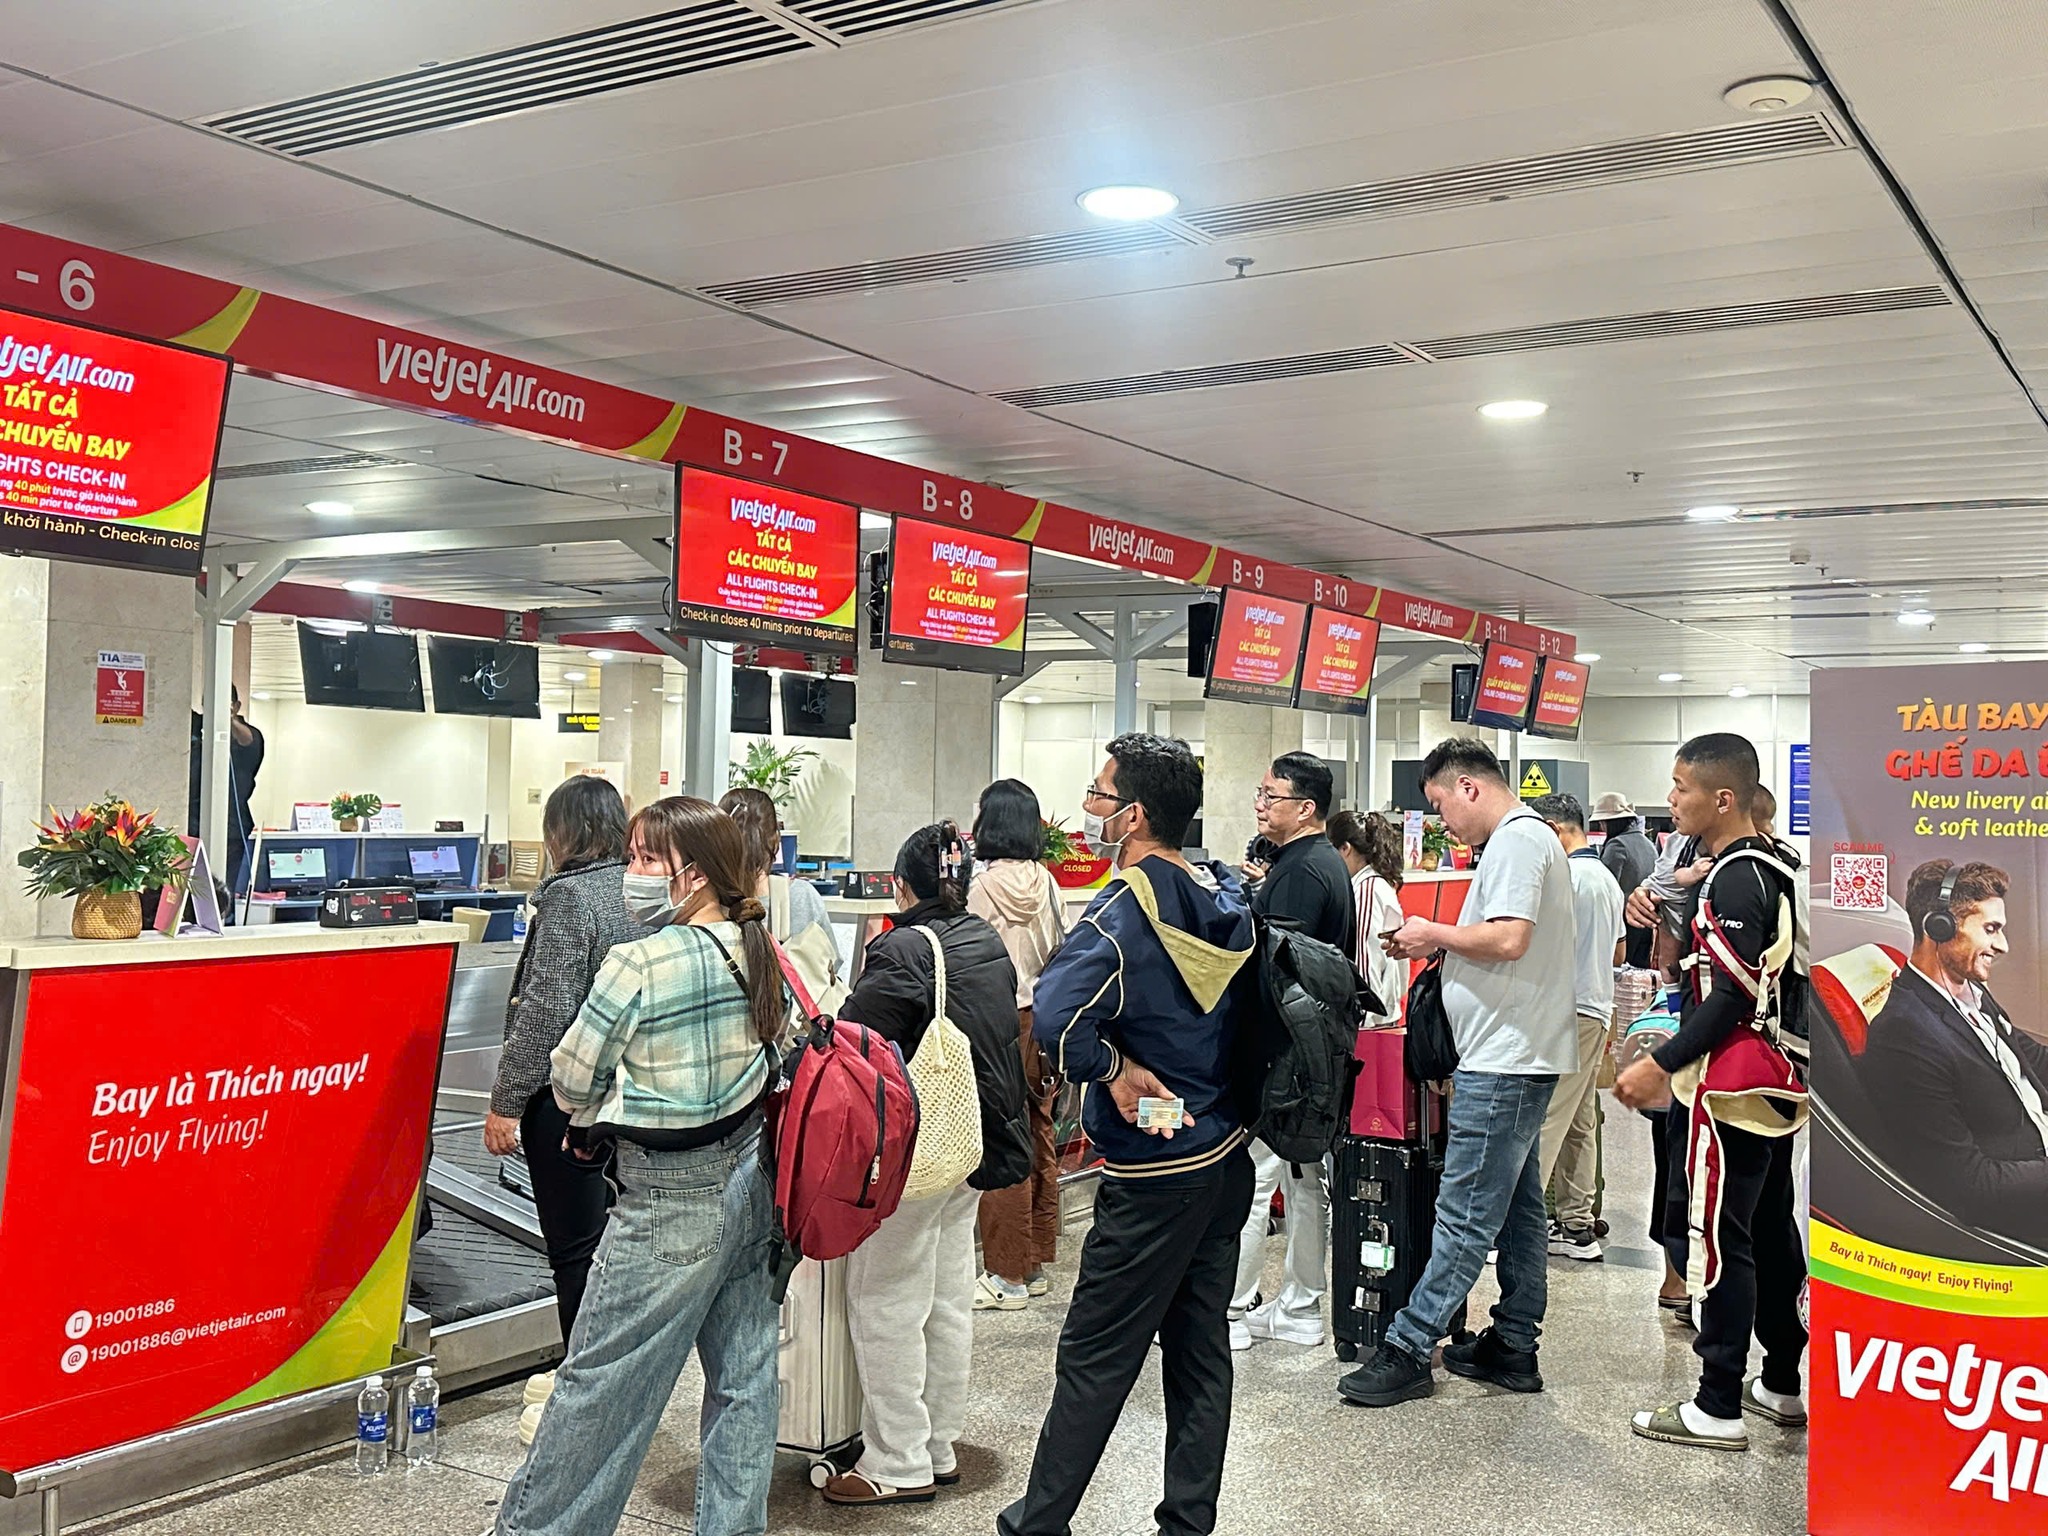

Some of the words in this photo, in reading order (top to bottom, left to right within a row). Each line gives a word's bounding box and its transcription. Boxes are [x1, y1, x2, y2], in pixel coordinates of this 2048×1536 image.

[60, 260, 95, 311] 6
[4, 380, 46, 411] TẤT
[49, 388, 78, 418] CẢ
[85, 435, 131, 461] BAY
[723, 428, 743, 466] B
[772, 441, 789, 476] 7
[15, 480, 28, 490] 40
[29, 483, 51, 494] phút
[45, 461, 126, 490] CHECK-IN
[6, 491, 20, 502] 40
[21, 495, 39, 505] min
[39, 497, 63, 508] prior
[64, 500, 74, 510] to
[74, 502, 119, 517] departure
[923, 480, 937, 512] B
[960, 490, 973, 520] 8
[4, 511, 40, 529] khởi
[45, 517, 86, 535] hành
[100, 526, 166, 547] Check-in
[728, 548, 751, 568] CÁC
[752, 554, 795, 576] CHUYẾN
[797, 563, 818, 580] BAY
[1233, 559, 1242, 584] B
[1255, 565, 1264, 590] 9
[726, 573, 742, 587] ALL
[744, 576, 778, 593] FLIGHTS
[780, 582, 818, 599] CHECK-IN
[929, 585, 946, 602] CÁC
[980, 596, 997, 610] BAY
[1315, 579, 1323, 602] B
[1334, 582, 1348, 607] 10
[681, 607, 719, 624] Check-in
[721, 613, 748, 628] closes
[750, 617, 761, 629] 40
[763, 620, 783, 633] mins
[784, 624, 802, 635] prior
[804, 626, 812, 637] to
[1485, 621, 1491, 640] B
[1499, 625, 1507, 643] 11
[100, 653, 120, 663] TIA
[1541, 634, 1547, 651] B
[1552, 637, 1561, 655] 12
[1897, 698, 1968, 732] TÀU
[1977, 702, 2048, 732] BAY
[1885, 737, 1968, 780] GHẾ
[1972, 749, 2030, 778] DA
[1911, 790, 1960, 809] New
[1966, 791, 2025, 814] livery
[1914, 817, 1934, 836] &
[1939, 817, 1979, 840] soft
[1834, 842, 1865, 852] SCAN
[1868, 842, 1884, 852] ME
[1725, 920, 1744, 929] PRO
[91, 1082, 159, 1118] Bay
[166, 1071, 196, 1107] là
[205, 1065, 284, 1102] Thích
[291, 1053, 370, 1096] ngay!
[88, 1126, 171, 1167] Enjoy
[178, 1110, 269, 1155] Flying!
[1829, 1242, 1852, 1261] Bay
[1854, 1250, 1865, 1263] là
[1868, 1255, 1897, 1273] Thích
[1900, 1267, 1932, 1282] ngay!
[1938, 1273, 1970, 1290] Enjoy
[1973, 1278, 2013, 1294] Flying!
[95, 1299, 175, 1329] 19001886
[91, 1306, 287, 1362] 19001886@vietjetair.com
[1645, 1431, 1672, 1441] crocs
